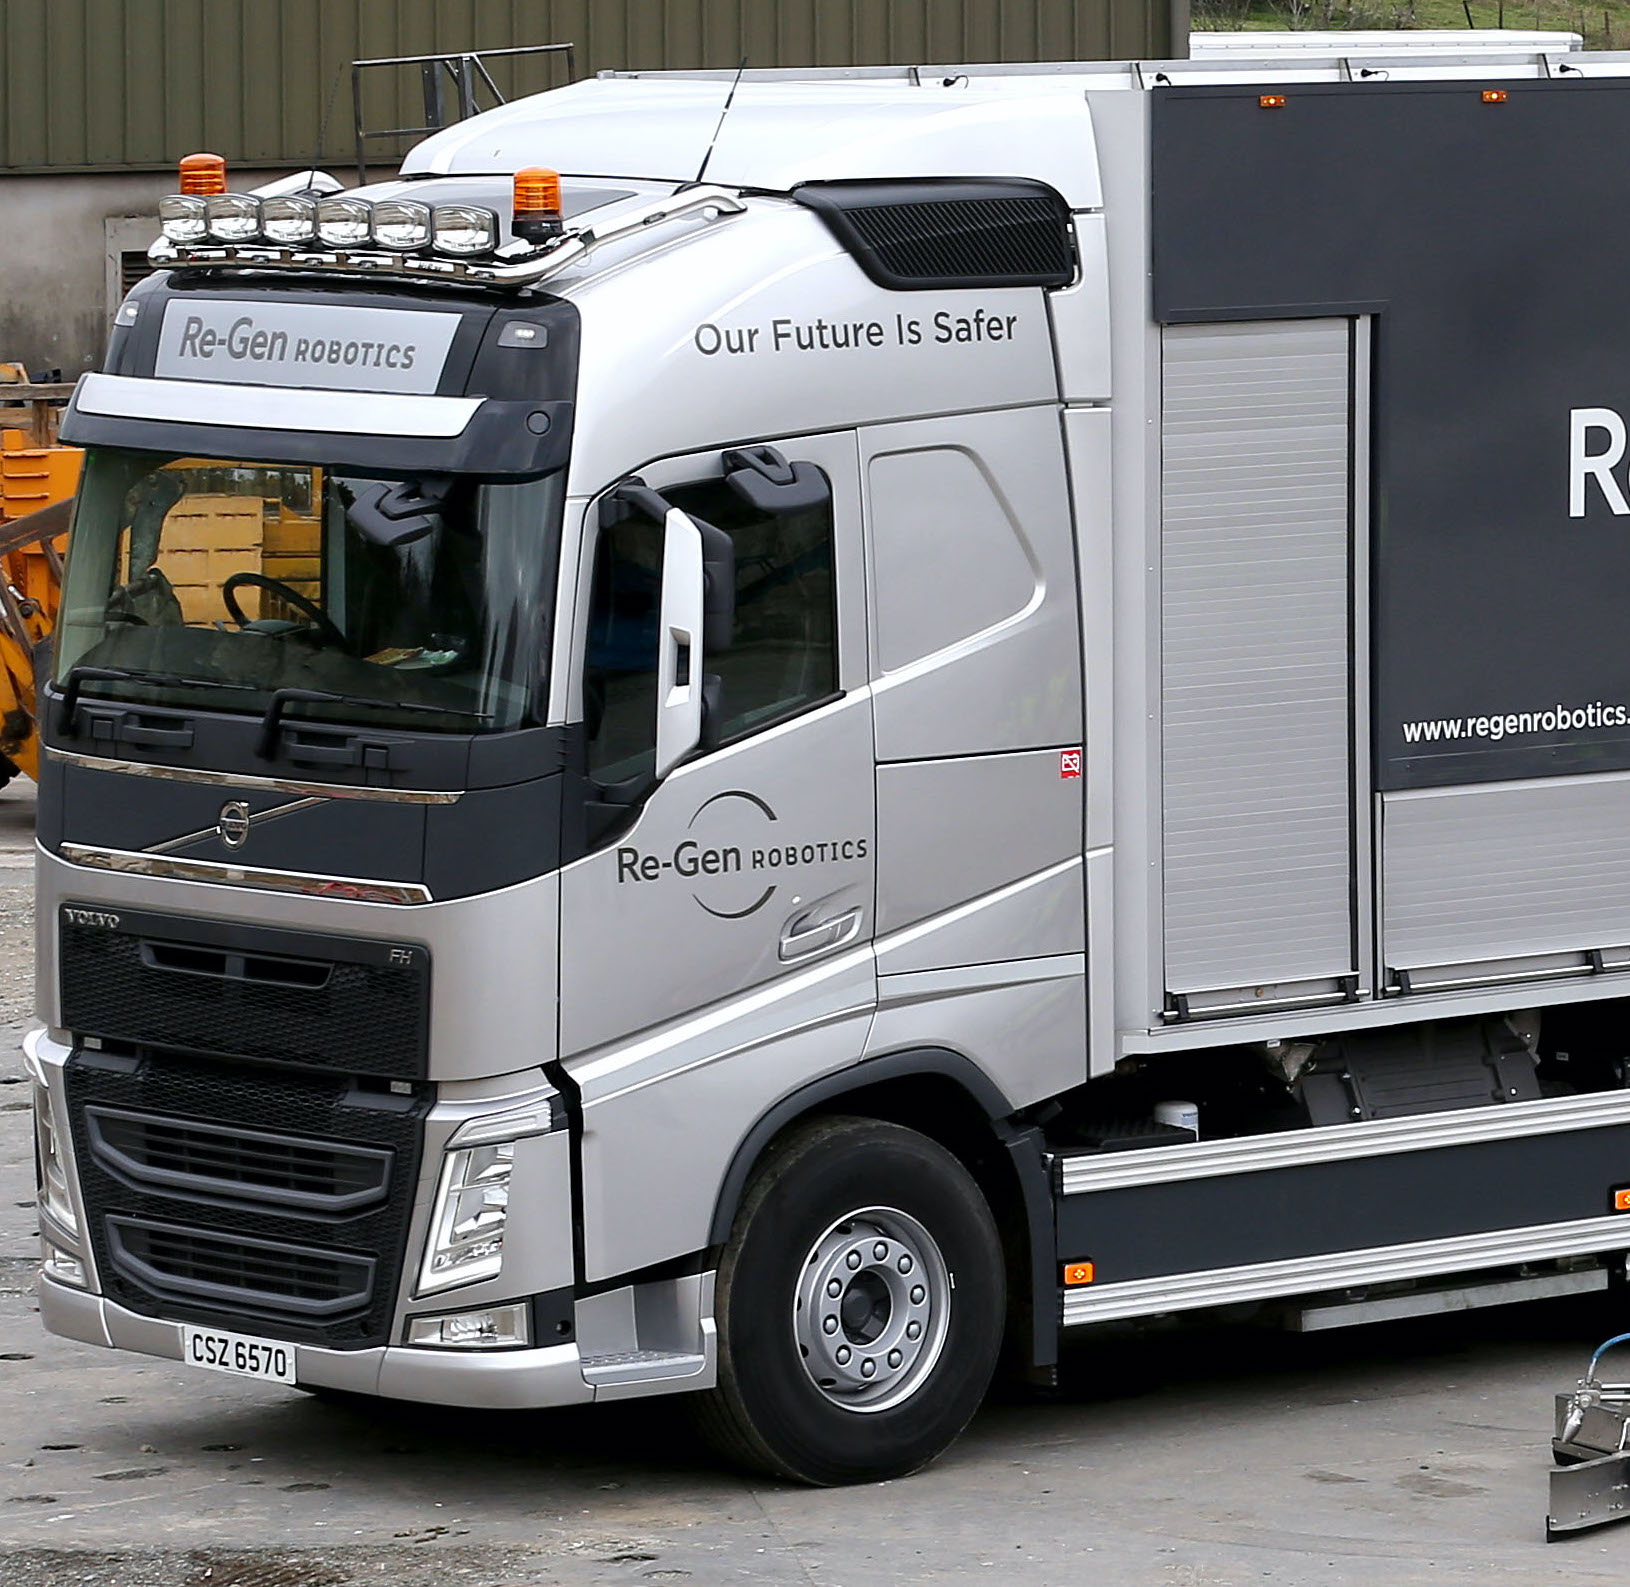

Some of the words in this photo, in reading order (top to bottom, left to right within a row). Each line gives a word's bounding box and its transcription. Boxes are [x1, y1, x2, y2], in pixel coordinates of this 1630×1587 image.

[178, 315, 288, 362] Re-Gen
[294, 338, 416, 370] ROBOTICS
[694, 323, 760, 356] Our
[772, 318, 885, 352] Future
[896, 313, 922, 346] Is
[933, 308, 1018, 344] Safer
[616, 840, 742, 884] Re-Gen
[751, 838, 868, 870] ROBOTICS
[64, 908, 120, 929] VOLVO
[389, 949, 414, 965] FH
[193, 1334, 230, 1367] CSZ
[235, 1341, 286, 1377] 6570
